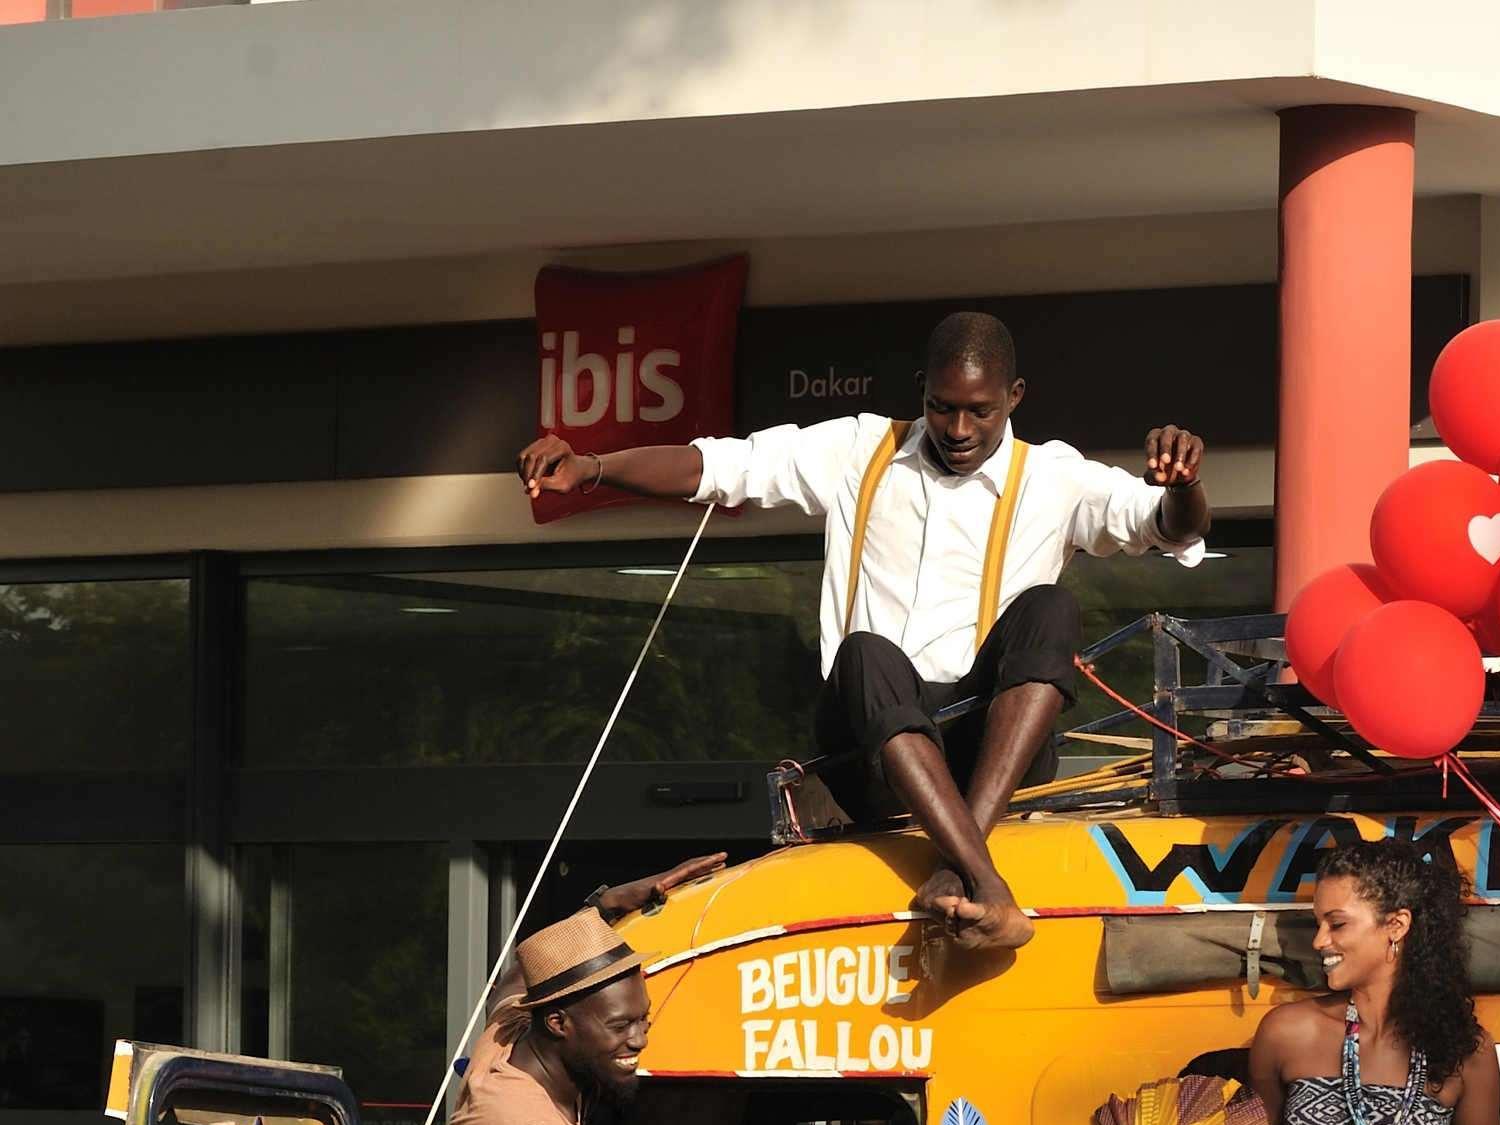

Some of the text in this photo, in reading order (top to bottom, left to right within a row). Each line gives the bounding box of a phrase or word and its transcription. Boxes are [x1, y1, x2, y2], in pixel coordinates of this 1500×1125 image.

[540, 325, 685, 430] ibis
[789, 366, 873, 399] Dakar
[737, 946, 914, 1014] BEUGUE
[741, 1018, 934, 1072] FALLOU
